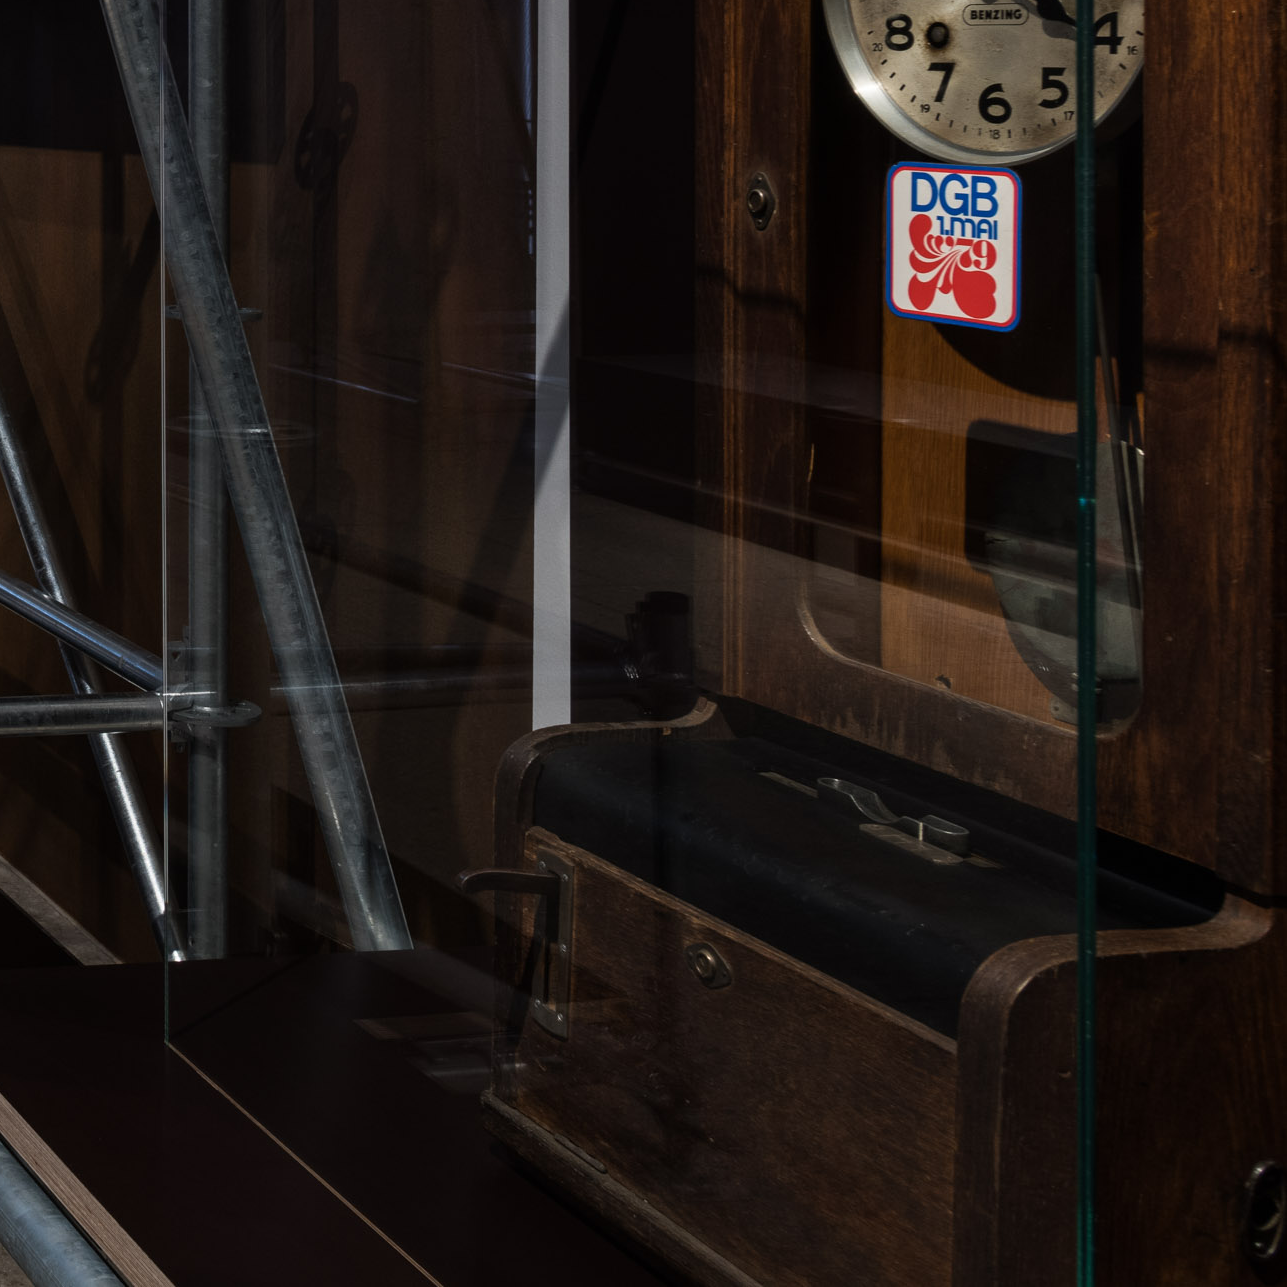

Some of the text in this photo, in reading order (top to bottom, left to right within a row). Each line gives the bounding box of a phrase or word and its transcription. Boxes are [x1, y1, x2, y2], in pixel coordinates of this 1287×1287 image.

[885, 14, 915, 51] 8
[970, 8, 1023, 21] BENZING
[1092, 11, 1126, 55] 4
[872, 43, 884, 52] 20
[1127, 45, 1139, 56] 16
[927, 62, 957, 103] 7
[1038, 67, 1069, 109] 5
[920, 103, 931, 113] 19
[978, 83, 1013, 125] 6
[989, 129, 1001, 140] 18
[910, 171, 999, 218] DGB
